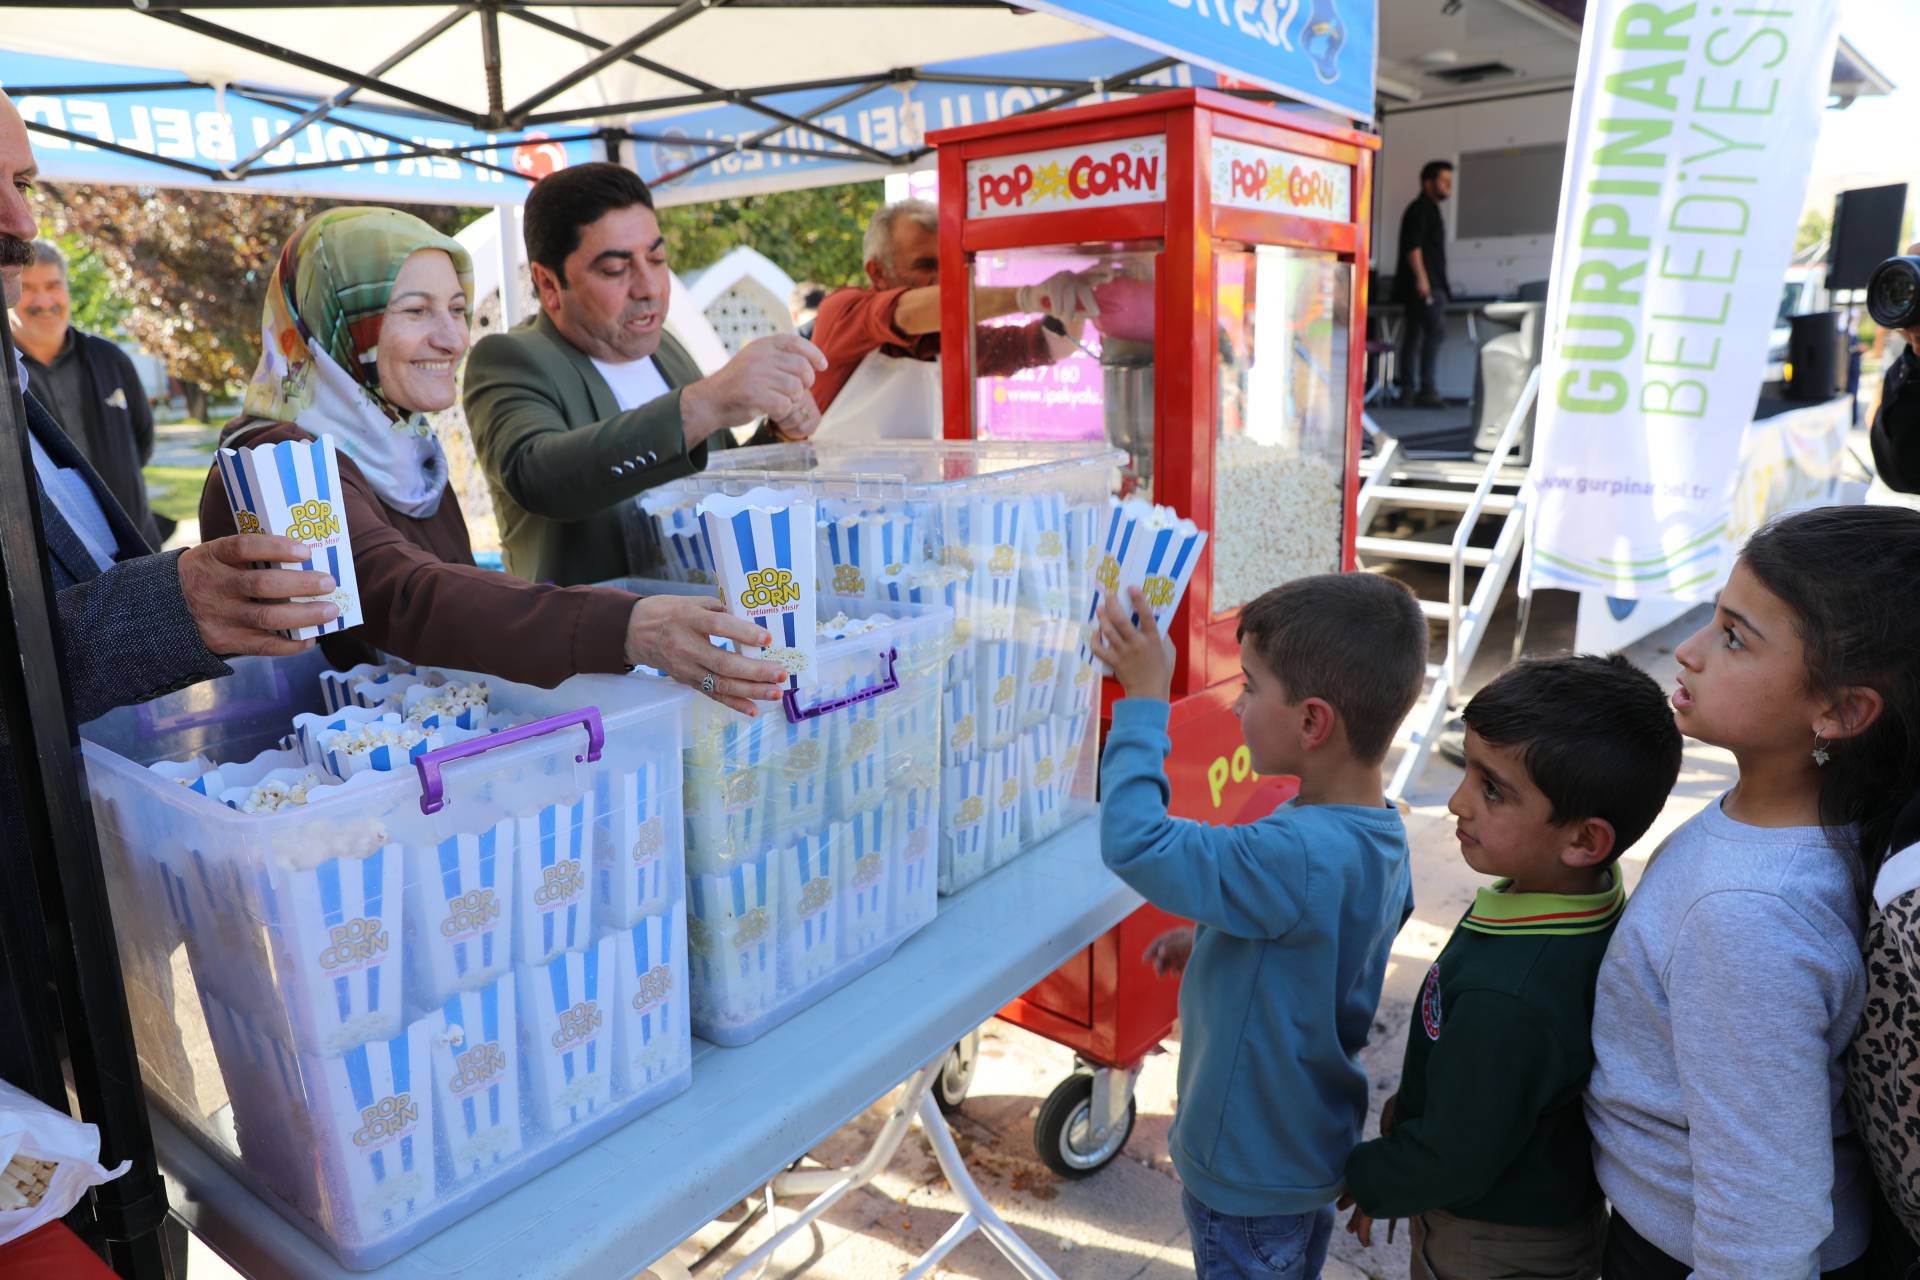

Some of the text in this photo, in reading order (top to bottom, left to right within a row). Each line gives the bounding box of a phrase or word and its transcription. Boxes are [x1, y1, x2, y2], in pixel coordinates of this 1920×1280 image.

[978, 152, 1159, 211] POP CORN
[1231, 159, 1334, 210] POP CORN
[291, 500, 332, 526] POP
[286, 514, 341, 543] CORN
[747, 567, 792, 592] POP
[741, 582, 801, 609] CORN
[543, 859, 581, 886] POP
[449, 889, 495, 915] POP
[534, 871, 585, 906] CORN
[329, 918, 382, 946] POP
[440, 898, 500, 937] CORN
[319, 930, 389, 969] CORN
[552, 1010, 603, 1048] CORN
[559, 1002, 597, 1031] POP
[450, 1050, 506, 1093] CORN
[456, 1042, 499, 1073] POP
[361, 1093, 411, 1122] POP
[353, 1102, 419, 1147] CORN
